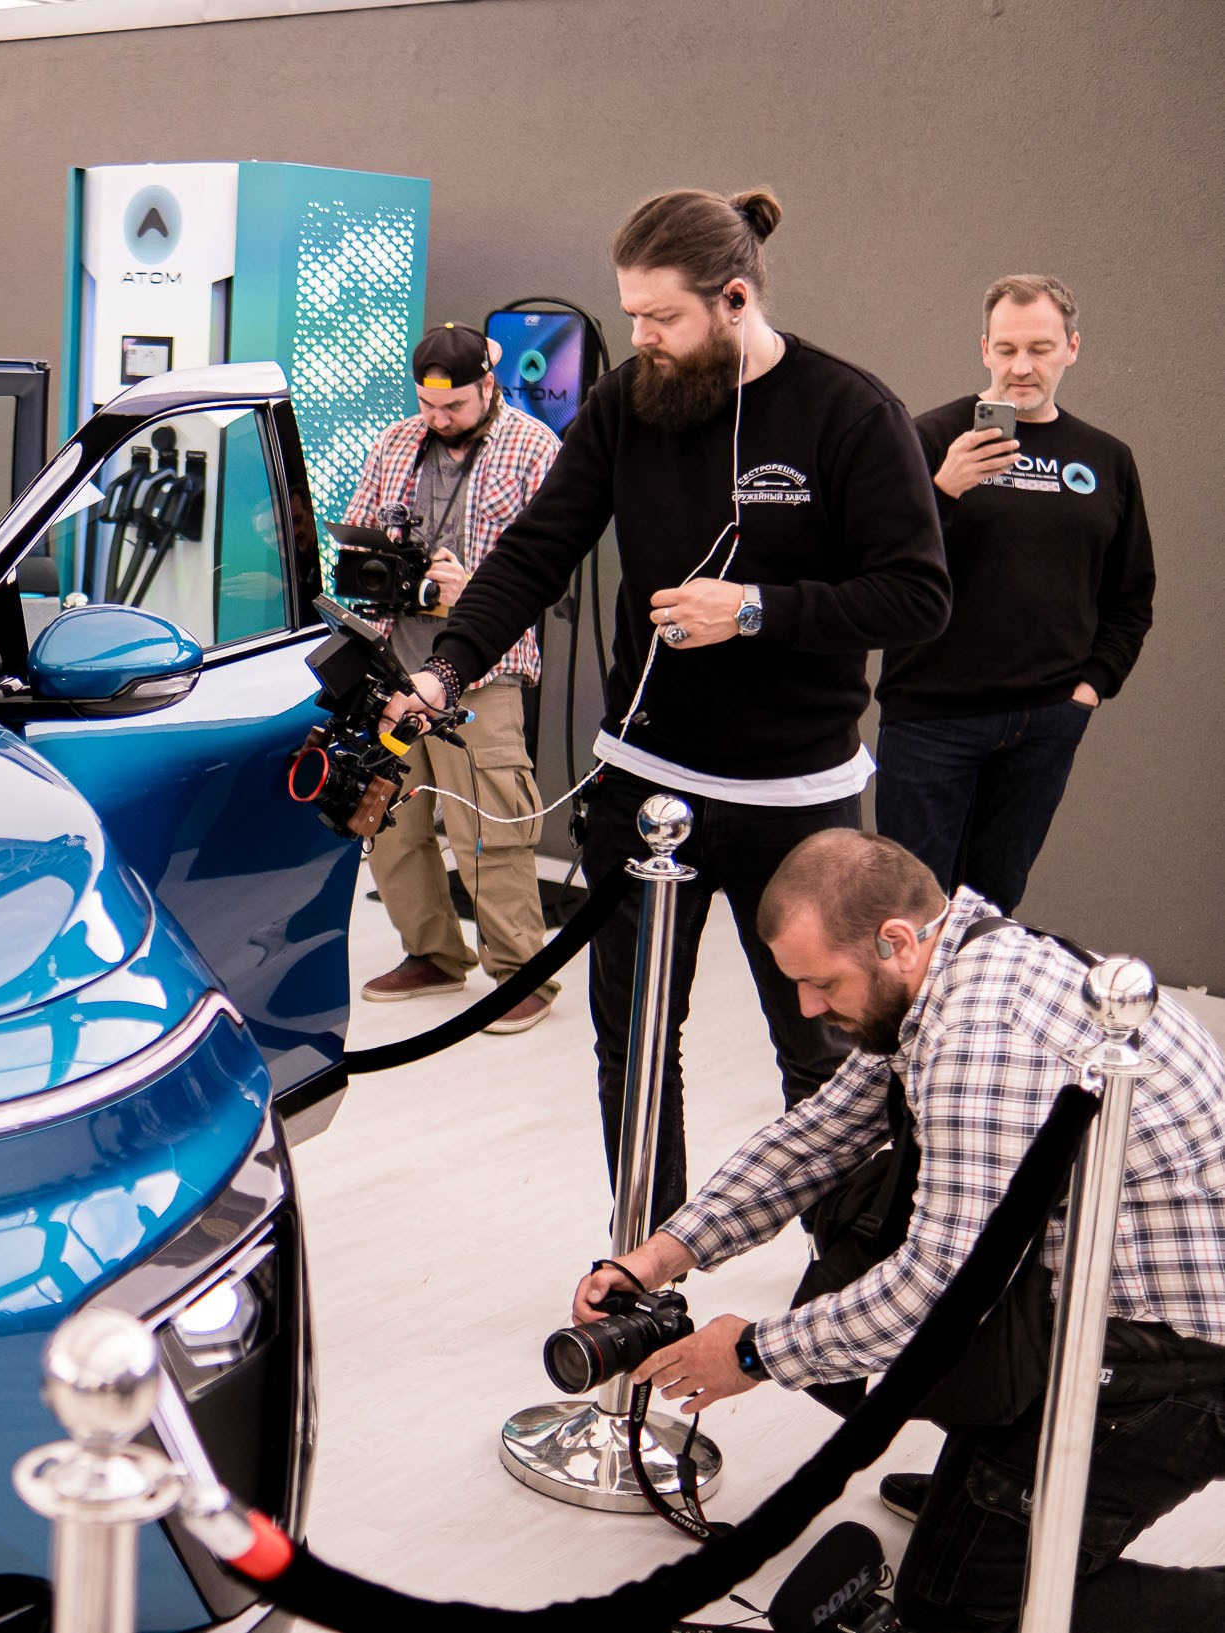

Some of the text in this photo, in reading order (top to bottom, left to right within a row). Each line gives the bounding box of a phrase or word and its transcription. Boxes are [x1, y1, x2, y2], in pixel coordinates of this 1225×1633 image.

[121, 272, 182, 284] ATOM
[502, 386, 567, 402] ATOM
[737, 463, 807, 485] СЕСТРОРЕЦКИЙ
[1014, 455, 1058, 474] OM
[784, 493, 811, 502] ЗАВОД
[633, 1385, 648, 1423] Canon
[670, 1510, 710, 1539] Canon
